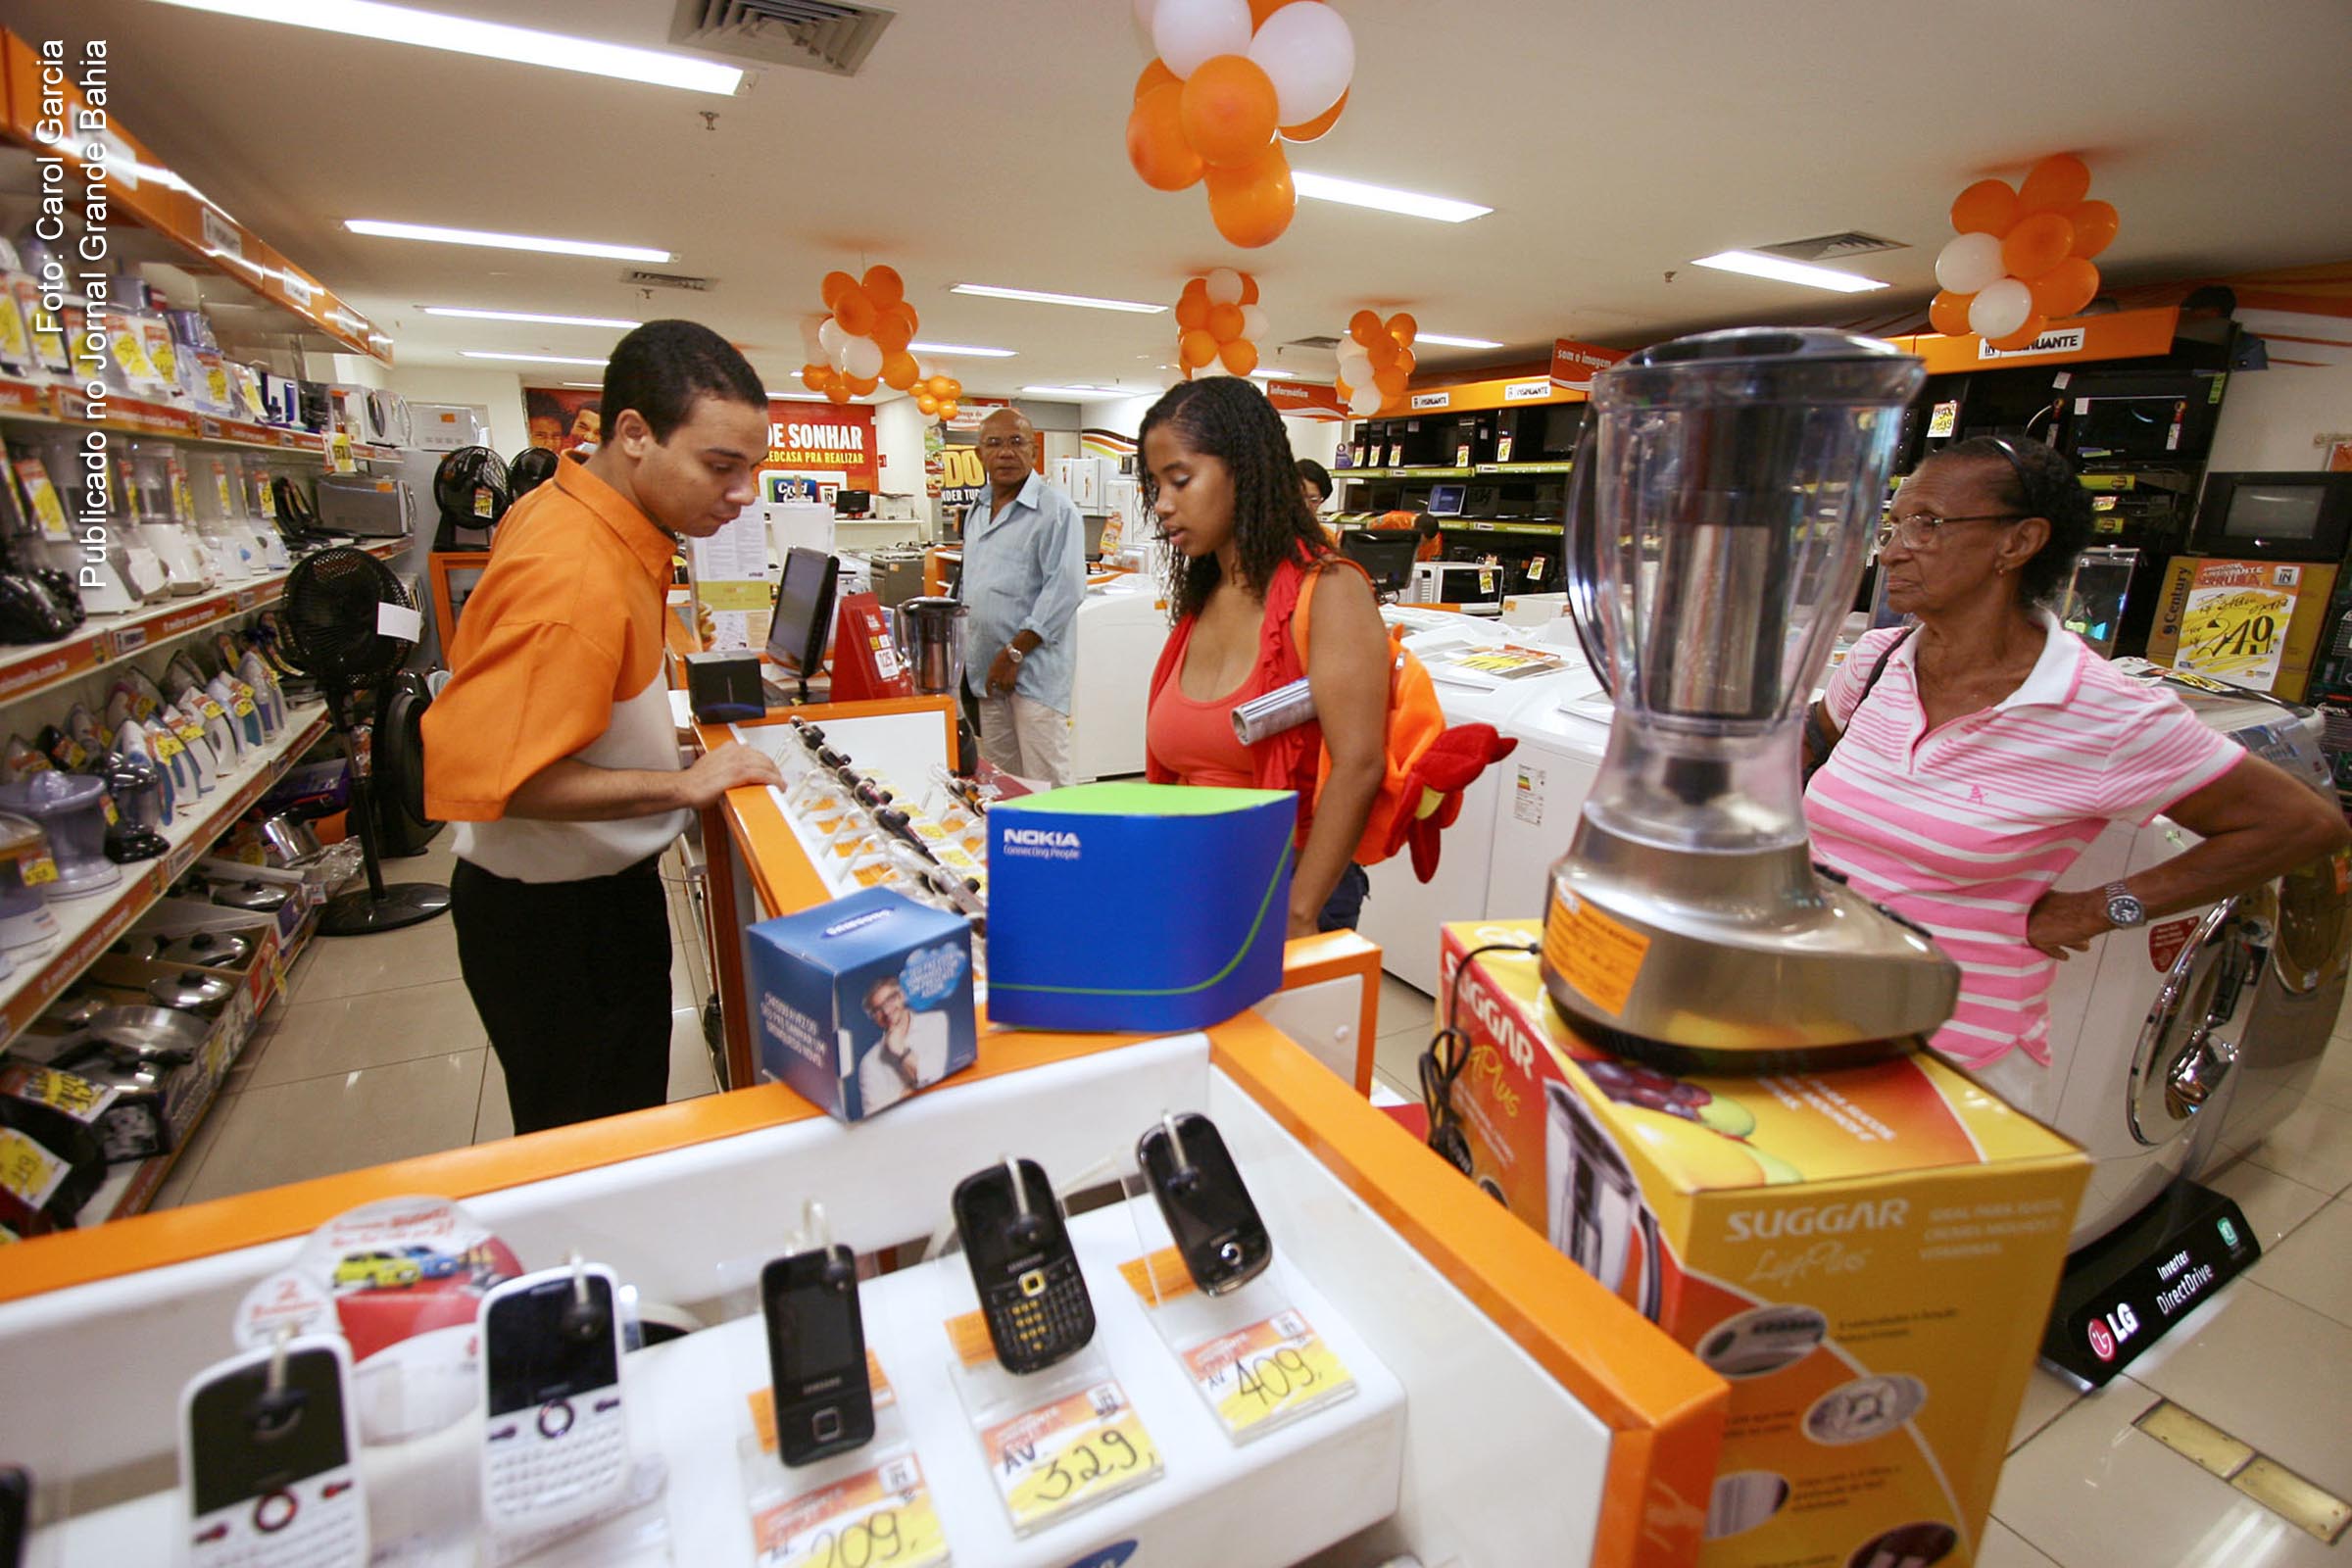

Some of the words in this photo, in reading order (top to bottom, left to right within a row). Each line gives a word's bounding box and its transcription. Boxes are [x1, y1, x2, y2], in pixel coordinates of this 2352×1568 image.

[788, 423, 863, 450] SONHAR
[767, 450, 803, 464] EDCASA
[805, 451, 822, 464] PRA
[824, 452, 864, 465] REALIZAR
[2165, 566, 2192, 622] Century
[1004, 828, 1082, 848] NOKIA
[1004, 844, 1050, 860] Connecting
[1050, 848, 1082, 861] People
[1724, 1197, 1910, 1244] SUGGAR
[2157, 1250, 2190, 1282] Inverter
[2156, 1263, 2214, 1317] DirectDrive
[2106, 1302, 2140, 1343] LG
